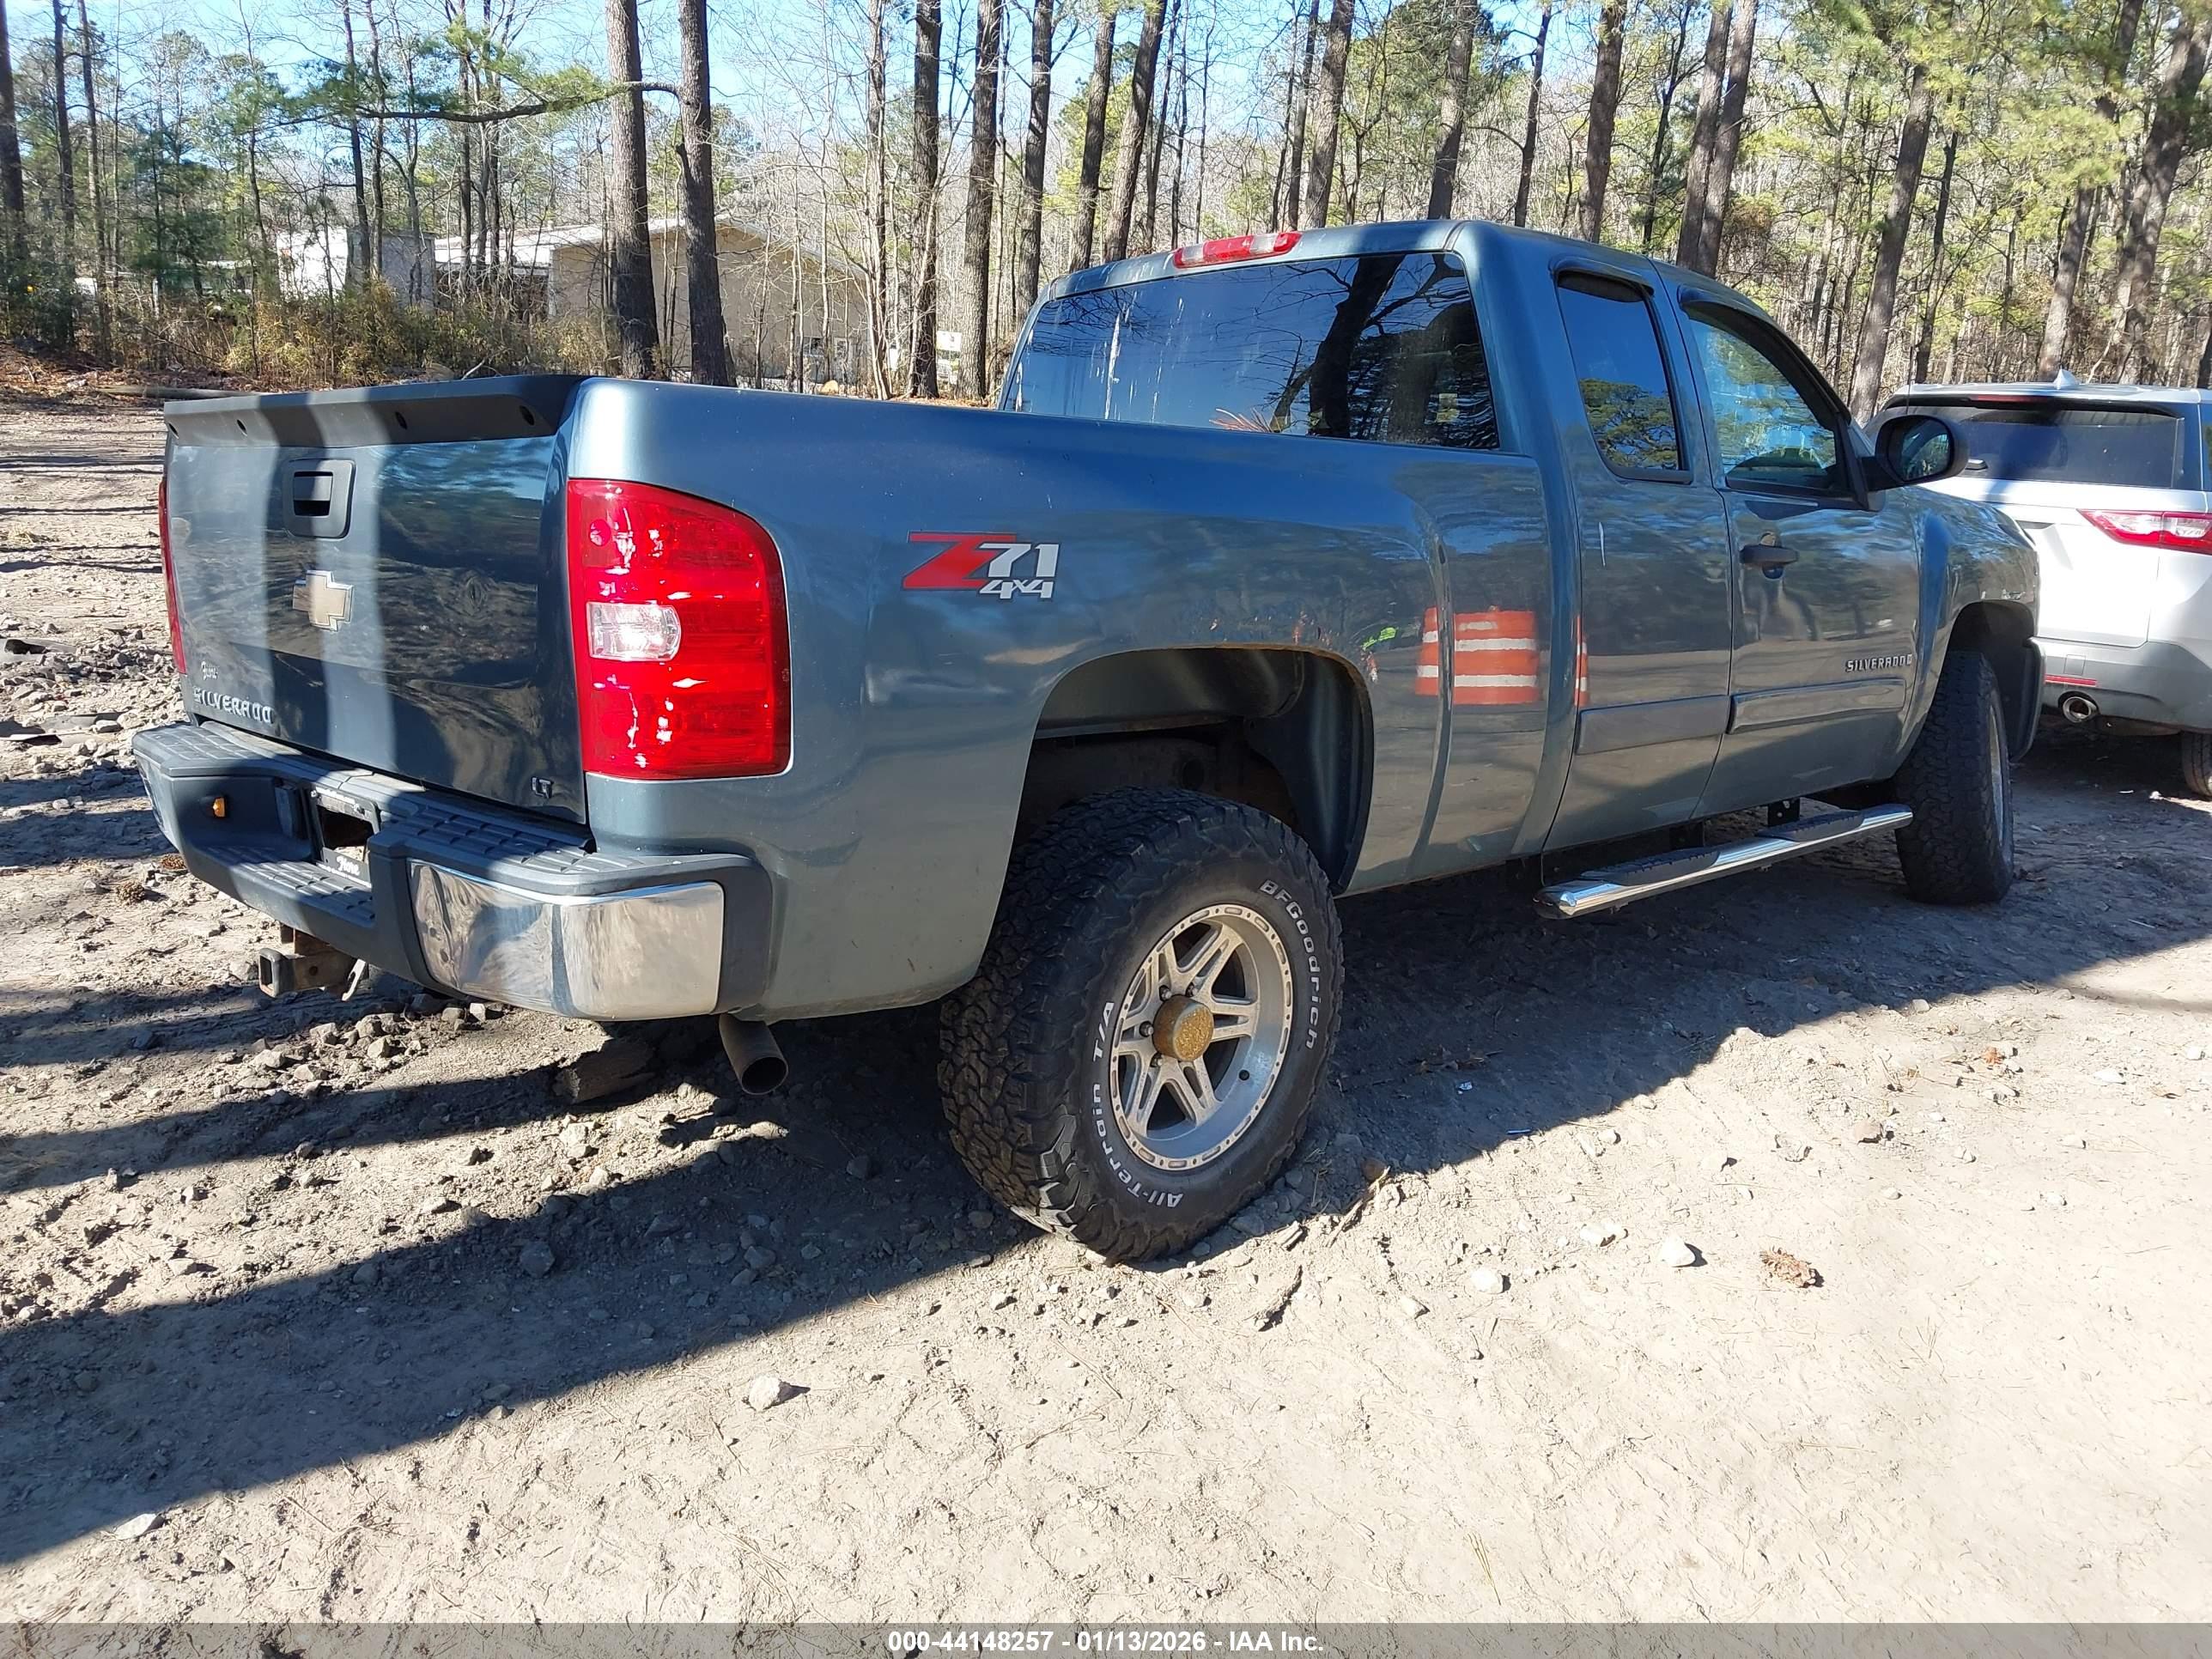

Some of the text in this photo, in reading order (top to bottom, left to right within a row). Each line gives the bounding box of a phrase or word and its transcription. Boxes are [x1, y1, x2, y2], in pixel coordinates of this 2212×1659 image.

[903, 531, 1060, 590] Z71
[1845, 654, 1913, 672] SILVERADO
[193, 686, 275, 724] SILVERADO
[532, 776, 552, 799] LT
[1260, 879, 1322, 1049] BFGoodrich
[1093, 1001, 1115, 1062] T/A
